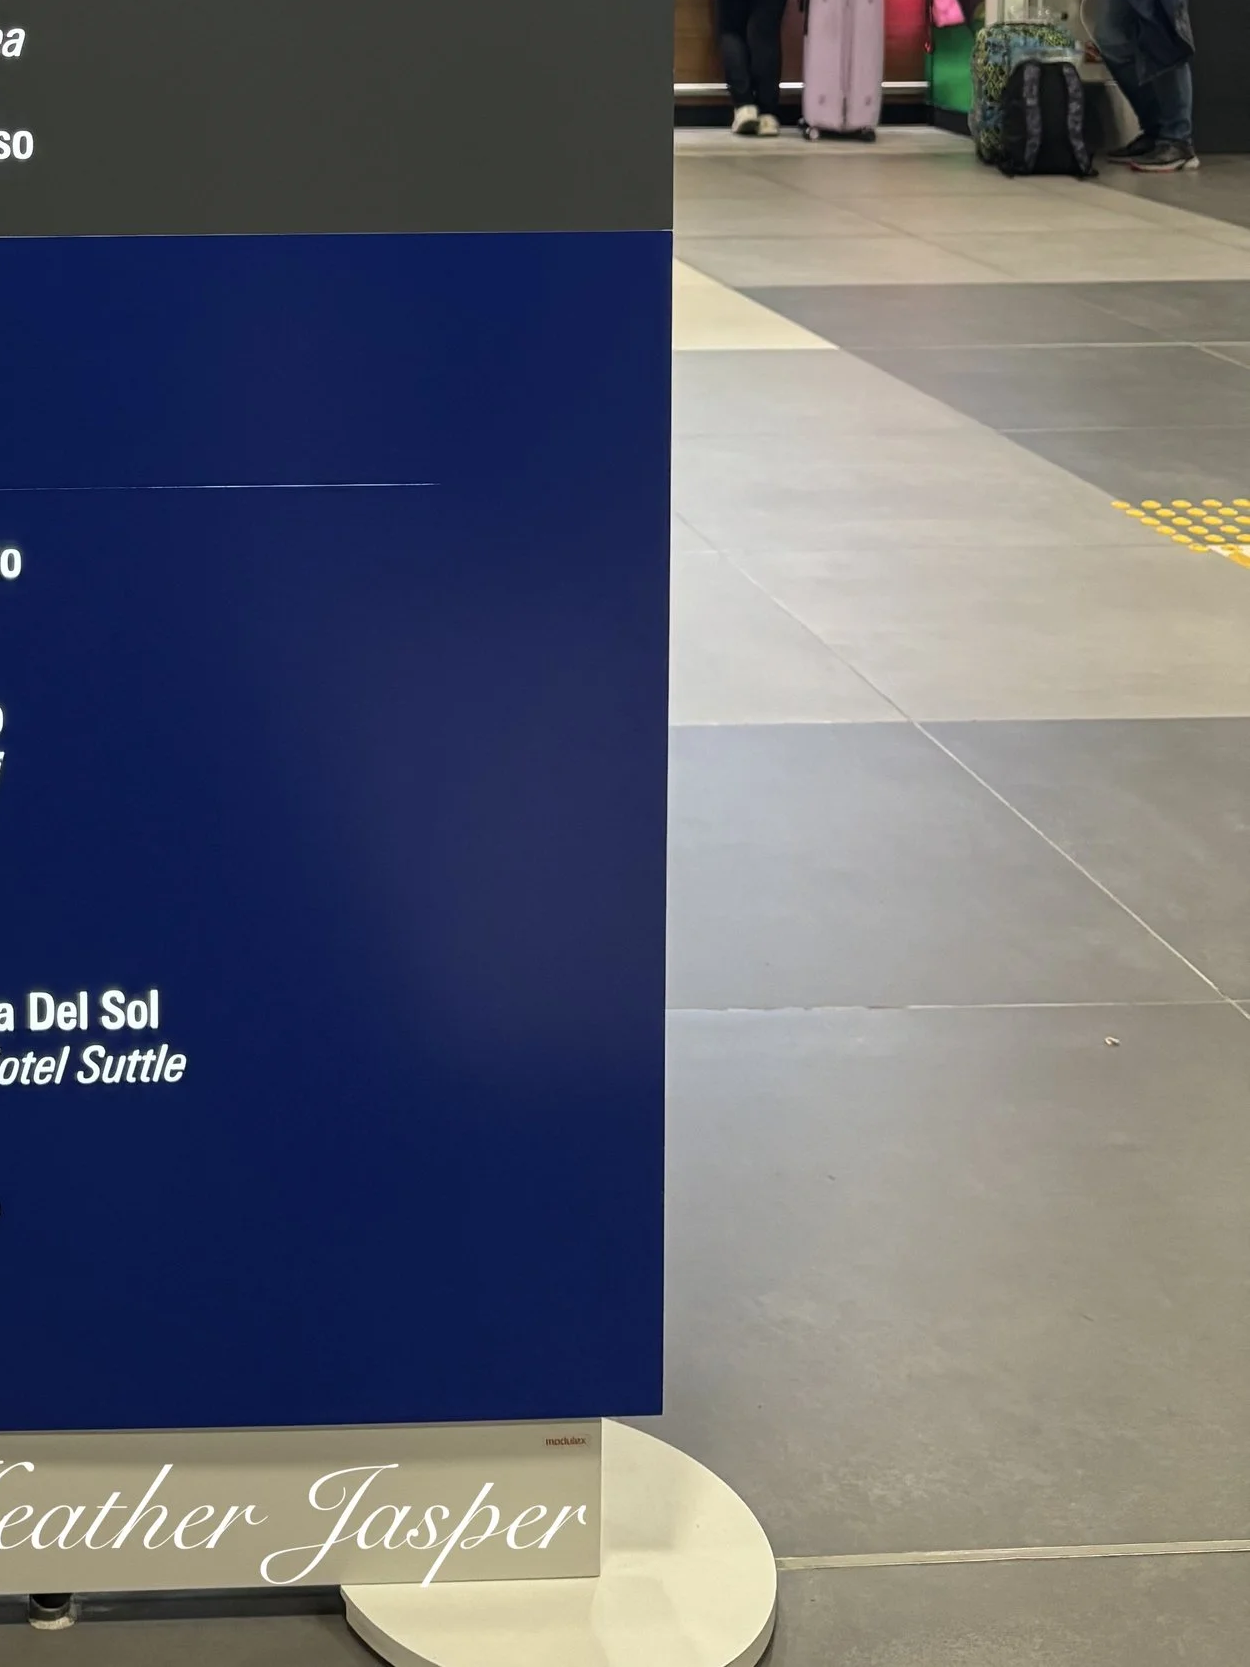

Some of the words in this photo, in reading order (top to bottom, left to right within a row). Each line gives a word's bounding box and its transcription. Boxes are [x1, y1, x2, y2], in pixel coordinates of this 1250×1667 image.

[30, 991, 87, 1030] Del
[102, 990, 158, 1029] Sol
[77, 1044, 186, 1083] Suttle
